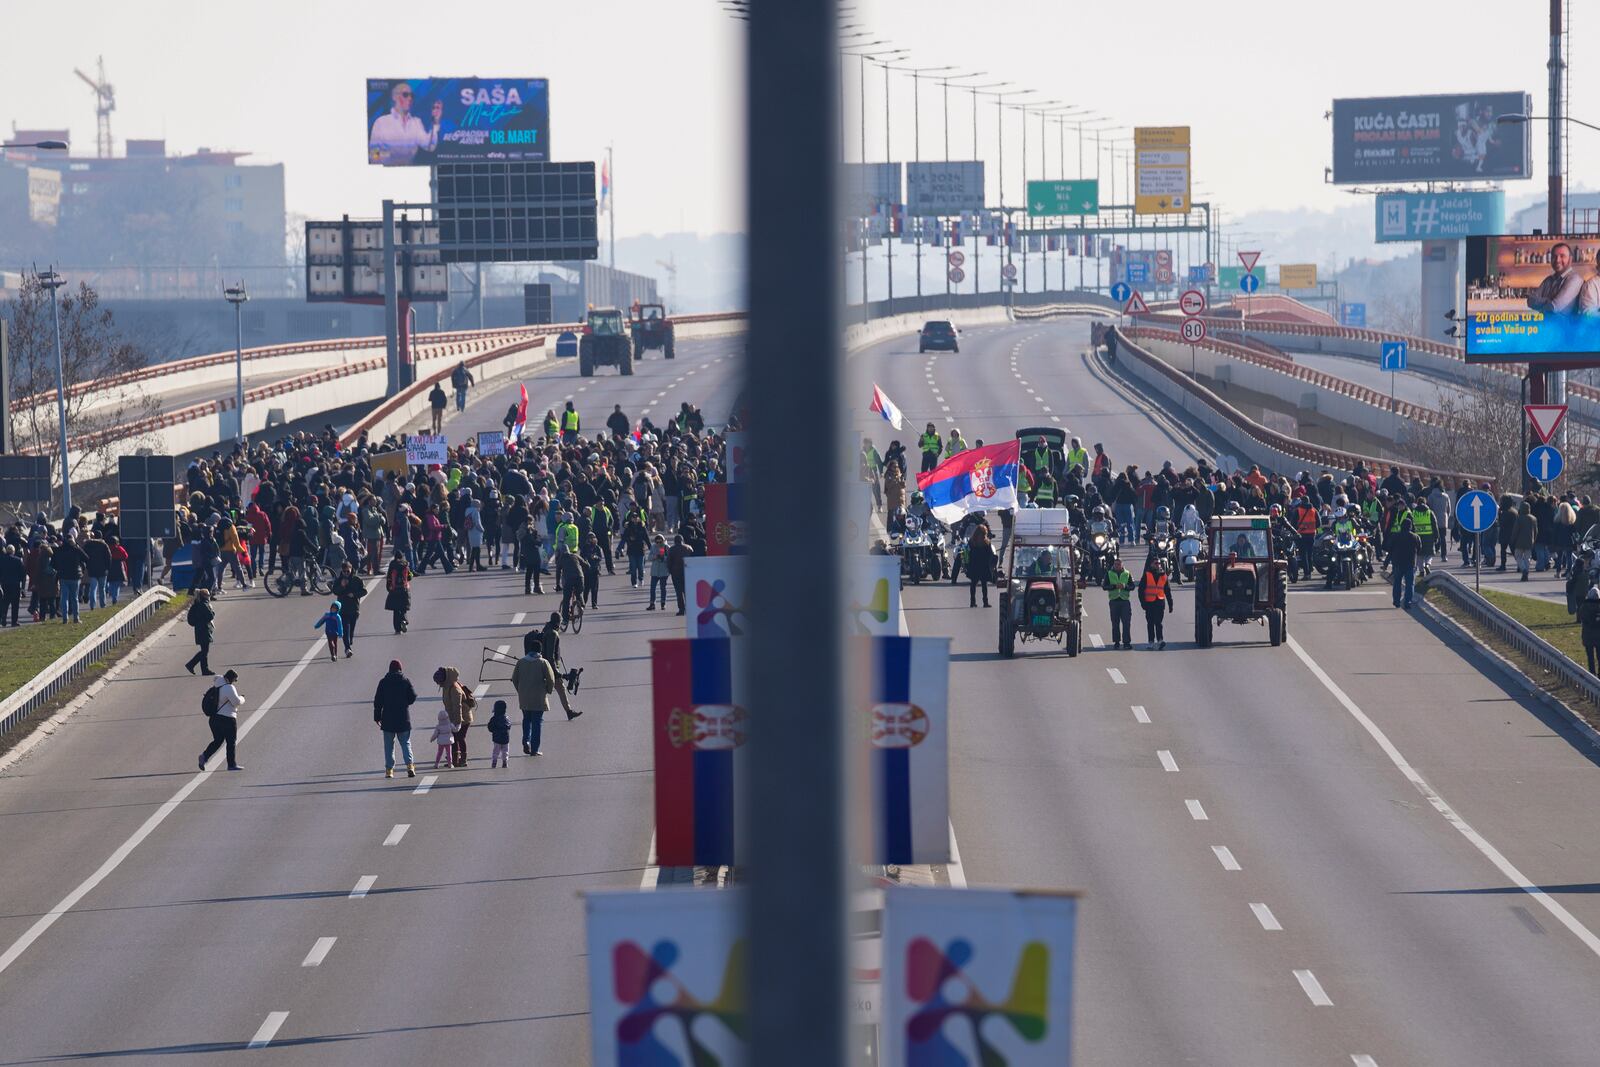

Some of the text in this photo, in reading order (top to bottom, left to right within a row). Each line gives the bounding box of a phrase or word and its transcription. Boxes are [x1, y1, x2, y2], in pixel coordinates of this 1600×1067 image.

[460, 84, 522, 105] SAŠA
[1354, 111, 1440, 130] KUĆA ČASTI
[490, 129, 537, 145] 08.MART
[1475, 312, 1544, 324] 20 godina tu za
[1185, 324, 1202, 337] 80
[1475, 324, 1538, 336] svaku Vašu po
